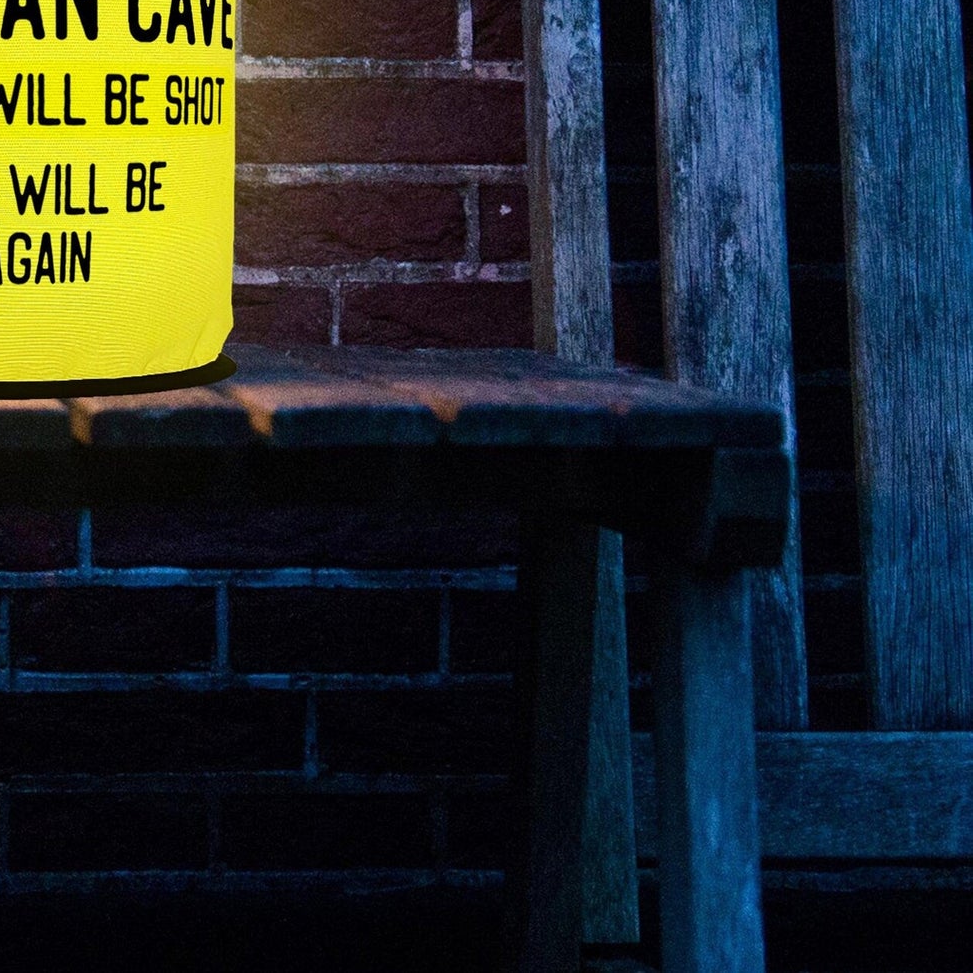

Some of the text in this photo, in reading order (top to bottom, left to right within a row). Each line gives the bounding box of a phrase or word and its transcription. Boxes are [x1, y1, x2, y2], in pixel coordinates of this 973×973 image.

[104, 73, 150, 126] BE
[165, 74, 225, 126] SHOT
[9, 163, 109, 216] WILL
[125, 161, 167, 213] BE
